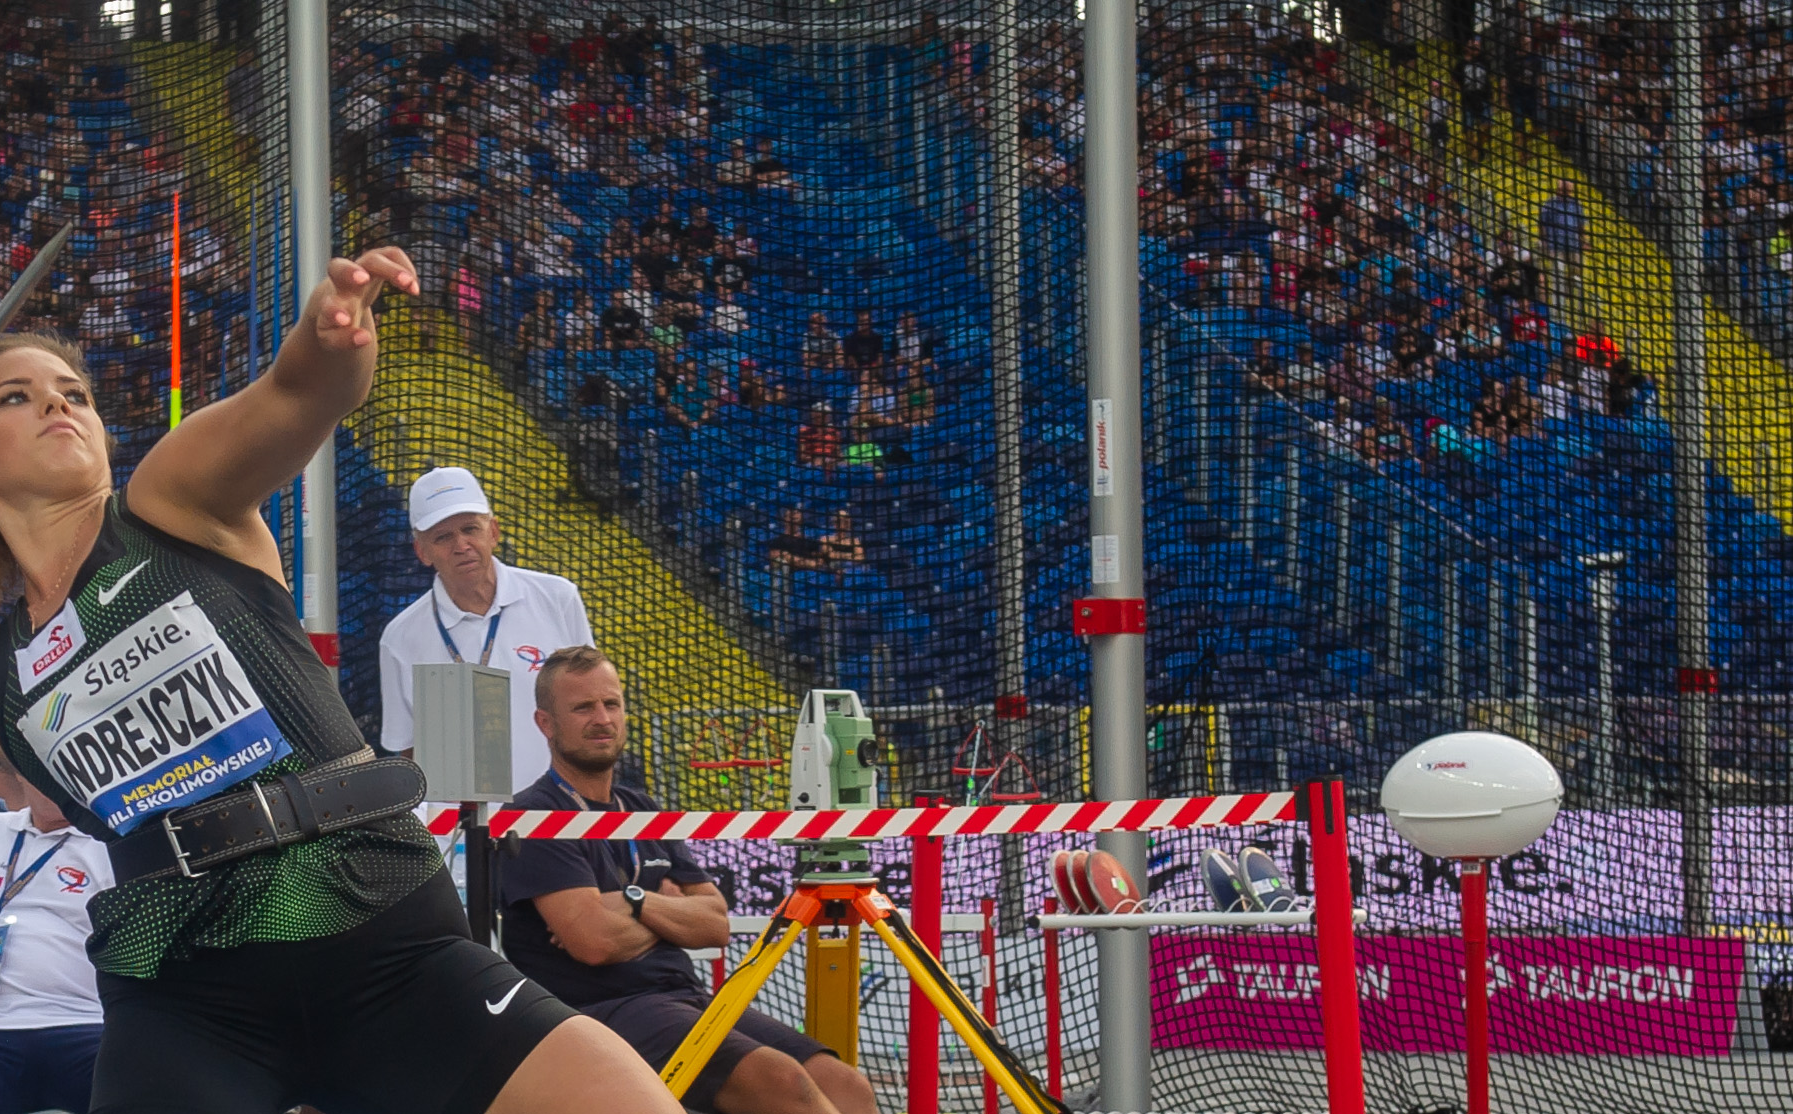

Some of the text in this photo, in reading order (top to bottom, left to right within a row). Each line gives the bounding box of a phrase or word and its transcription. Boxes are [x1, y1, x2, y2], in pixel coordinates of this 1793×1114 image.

[1096, 420, 1110, 470] polanik
[34, 636, 72, 672] ORLEN
[84, 622, 191, 696] Śląskie.
[121, 754, 216, 804] MEMORIAŁ
[138, 738, 273, 813] SKOLIMOWSKIEJ
[1520, 964, 1693, 1002] TAURON
